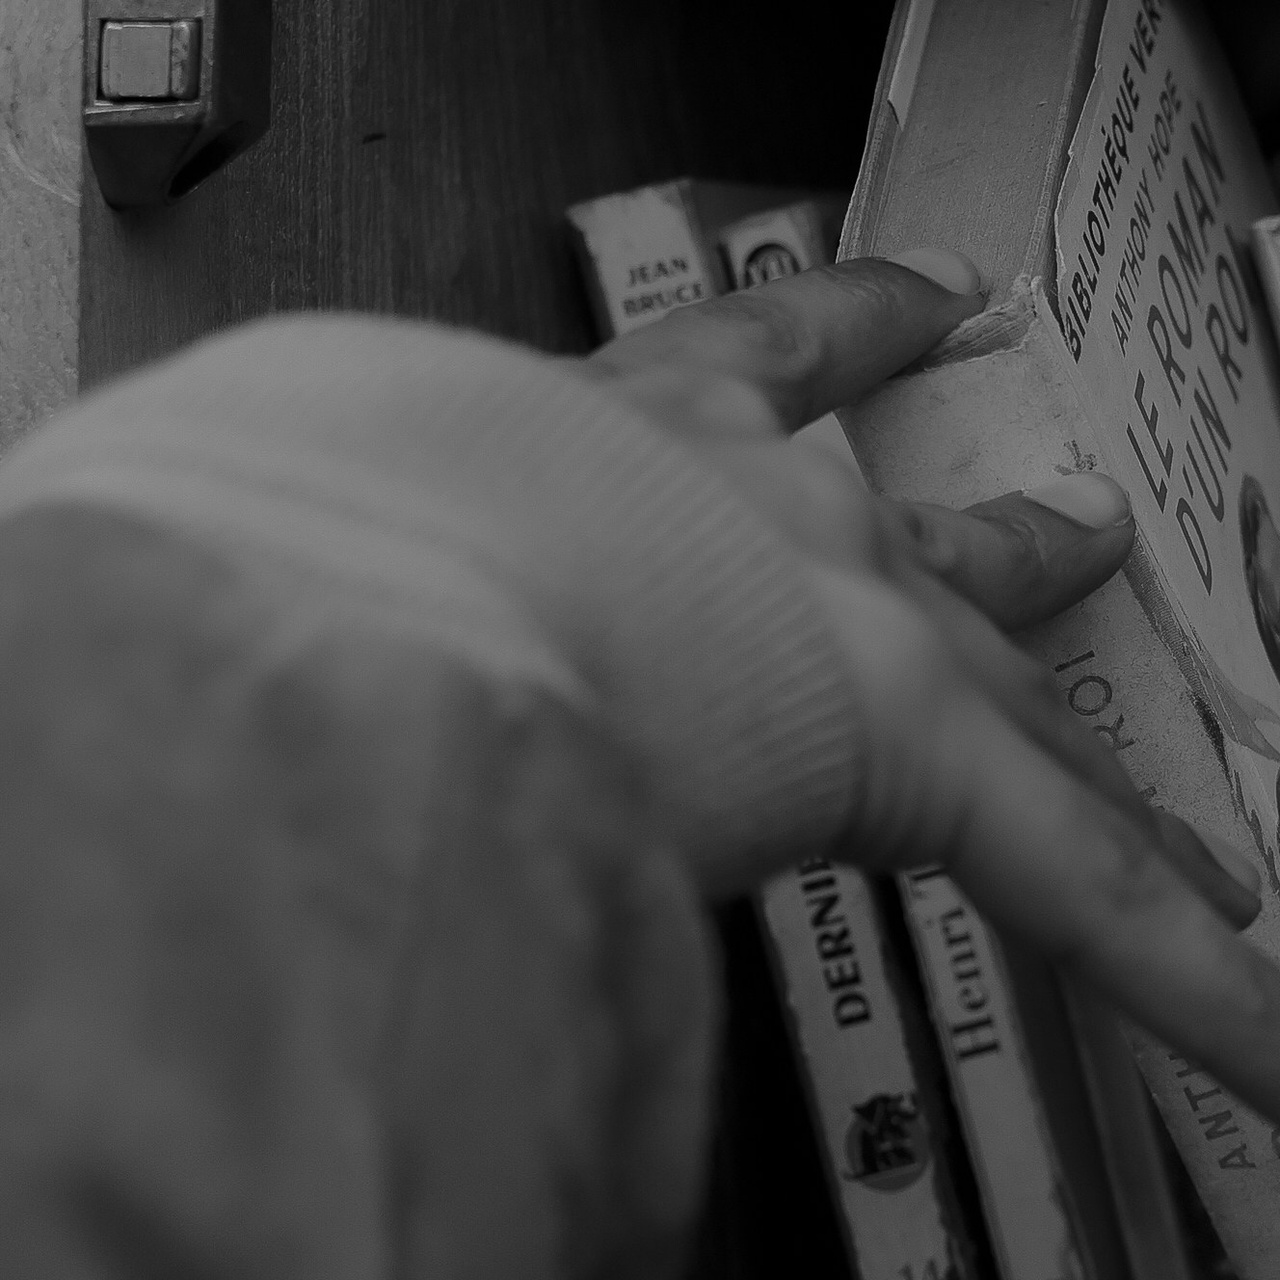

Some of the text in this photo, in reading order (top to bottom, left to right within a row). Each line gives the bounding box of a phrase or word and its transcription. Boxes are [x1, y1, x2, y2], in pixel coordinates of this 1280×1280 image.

[1111, 68, 1182, 358] ANTHONY HOPE
[1126, 99, 1226, 514] LE ROMAN
[1176, 223, 1253, 597] D'UN ROI
[941, 907, 1001, 1061] Henri
